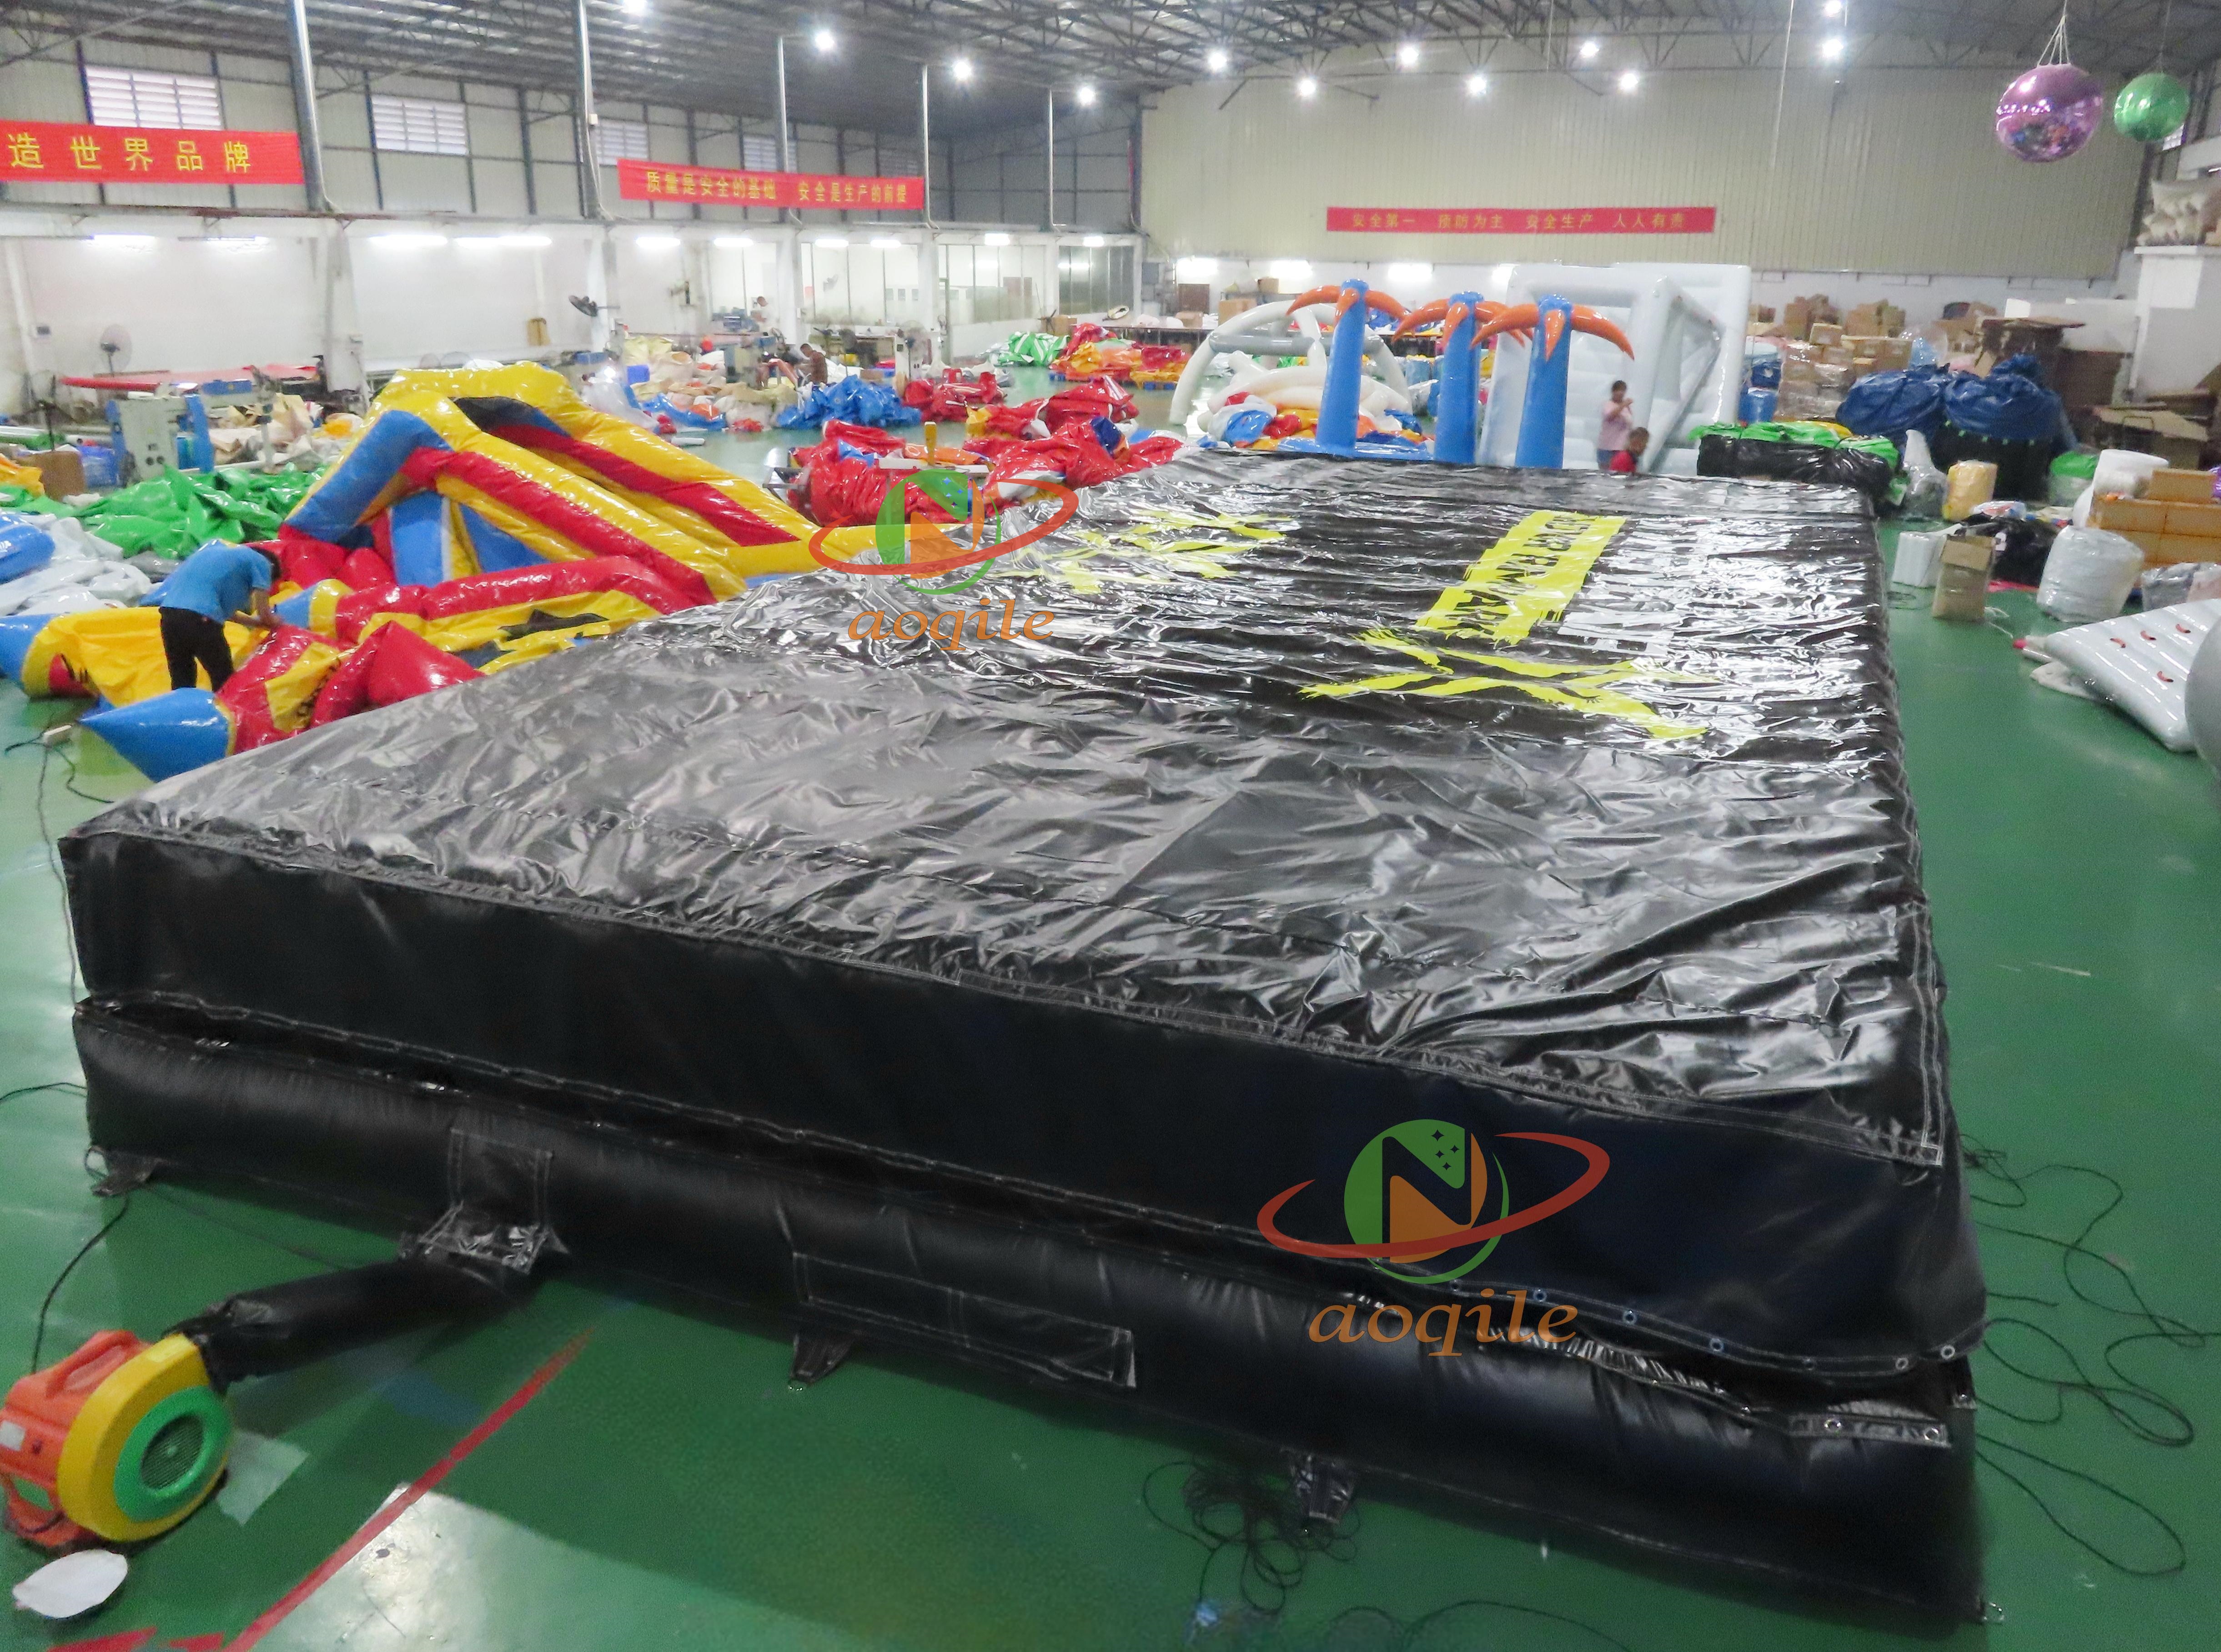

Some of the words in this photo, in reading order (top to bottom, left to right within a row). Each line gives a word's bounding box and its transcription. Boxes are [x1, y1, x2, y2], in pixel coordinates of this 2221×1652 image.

[8, 132, 251, 173] 造世界品牌
